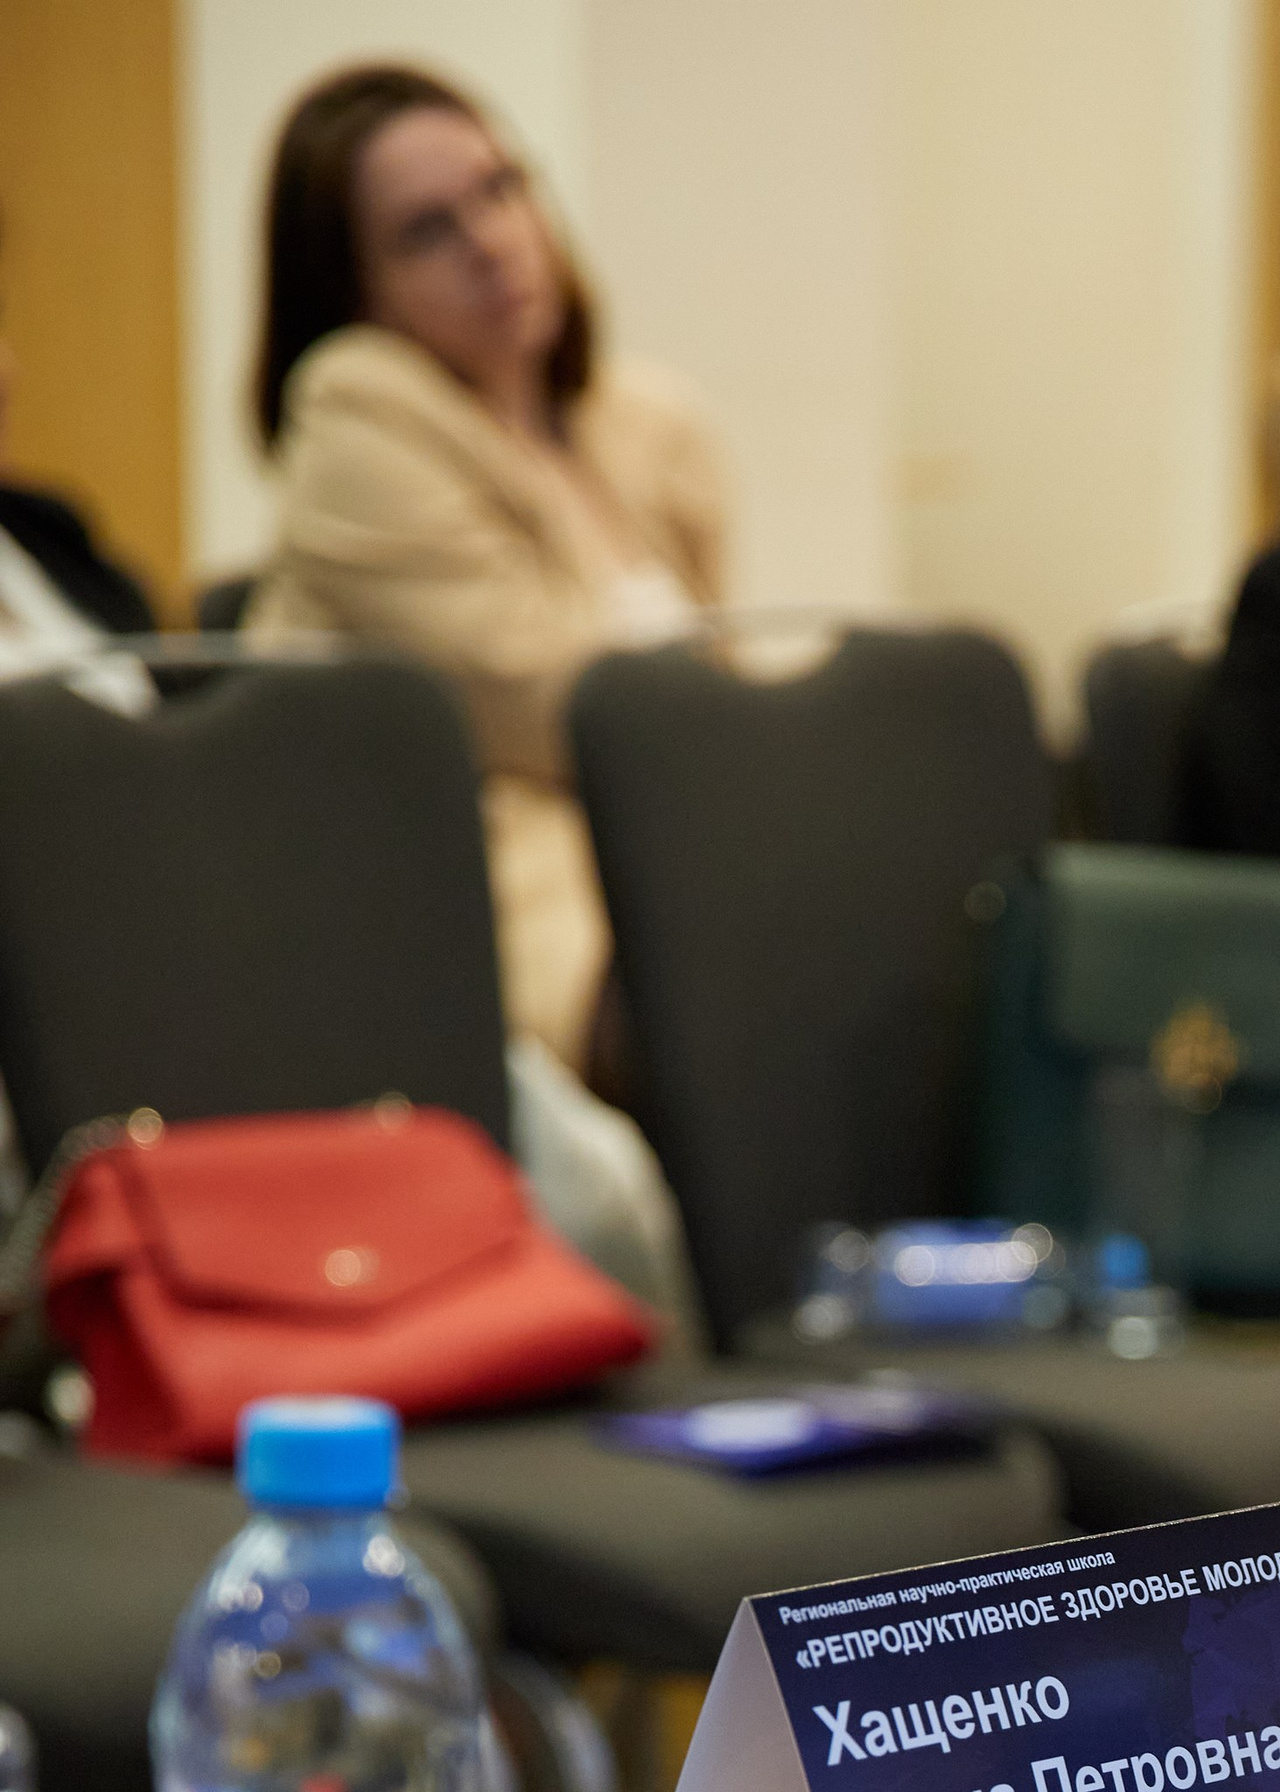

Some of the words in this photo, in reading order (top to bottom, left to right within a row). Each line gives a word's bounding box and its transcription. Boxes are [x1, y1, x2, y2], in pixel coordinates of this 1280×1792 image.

[779, 1590, 896, 1625] Региональная
[898, 1559, 1064, 1602] научно-практическая
[1067, 1551, 1115, 1572] школа
[795, 1595, 1059, 1669] «РЕПРОДУКТИВНОЕ
[1060, 1568, 1201, 1621] ЗДОРОВЬЕ
[812, 1675, 1070, 1766] Хащенко
